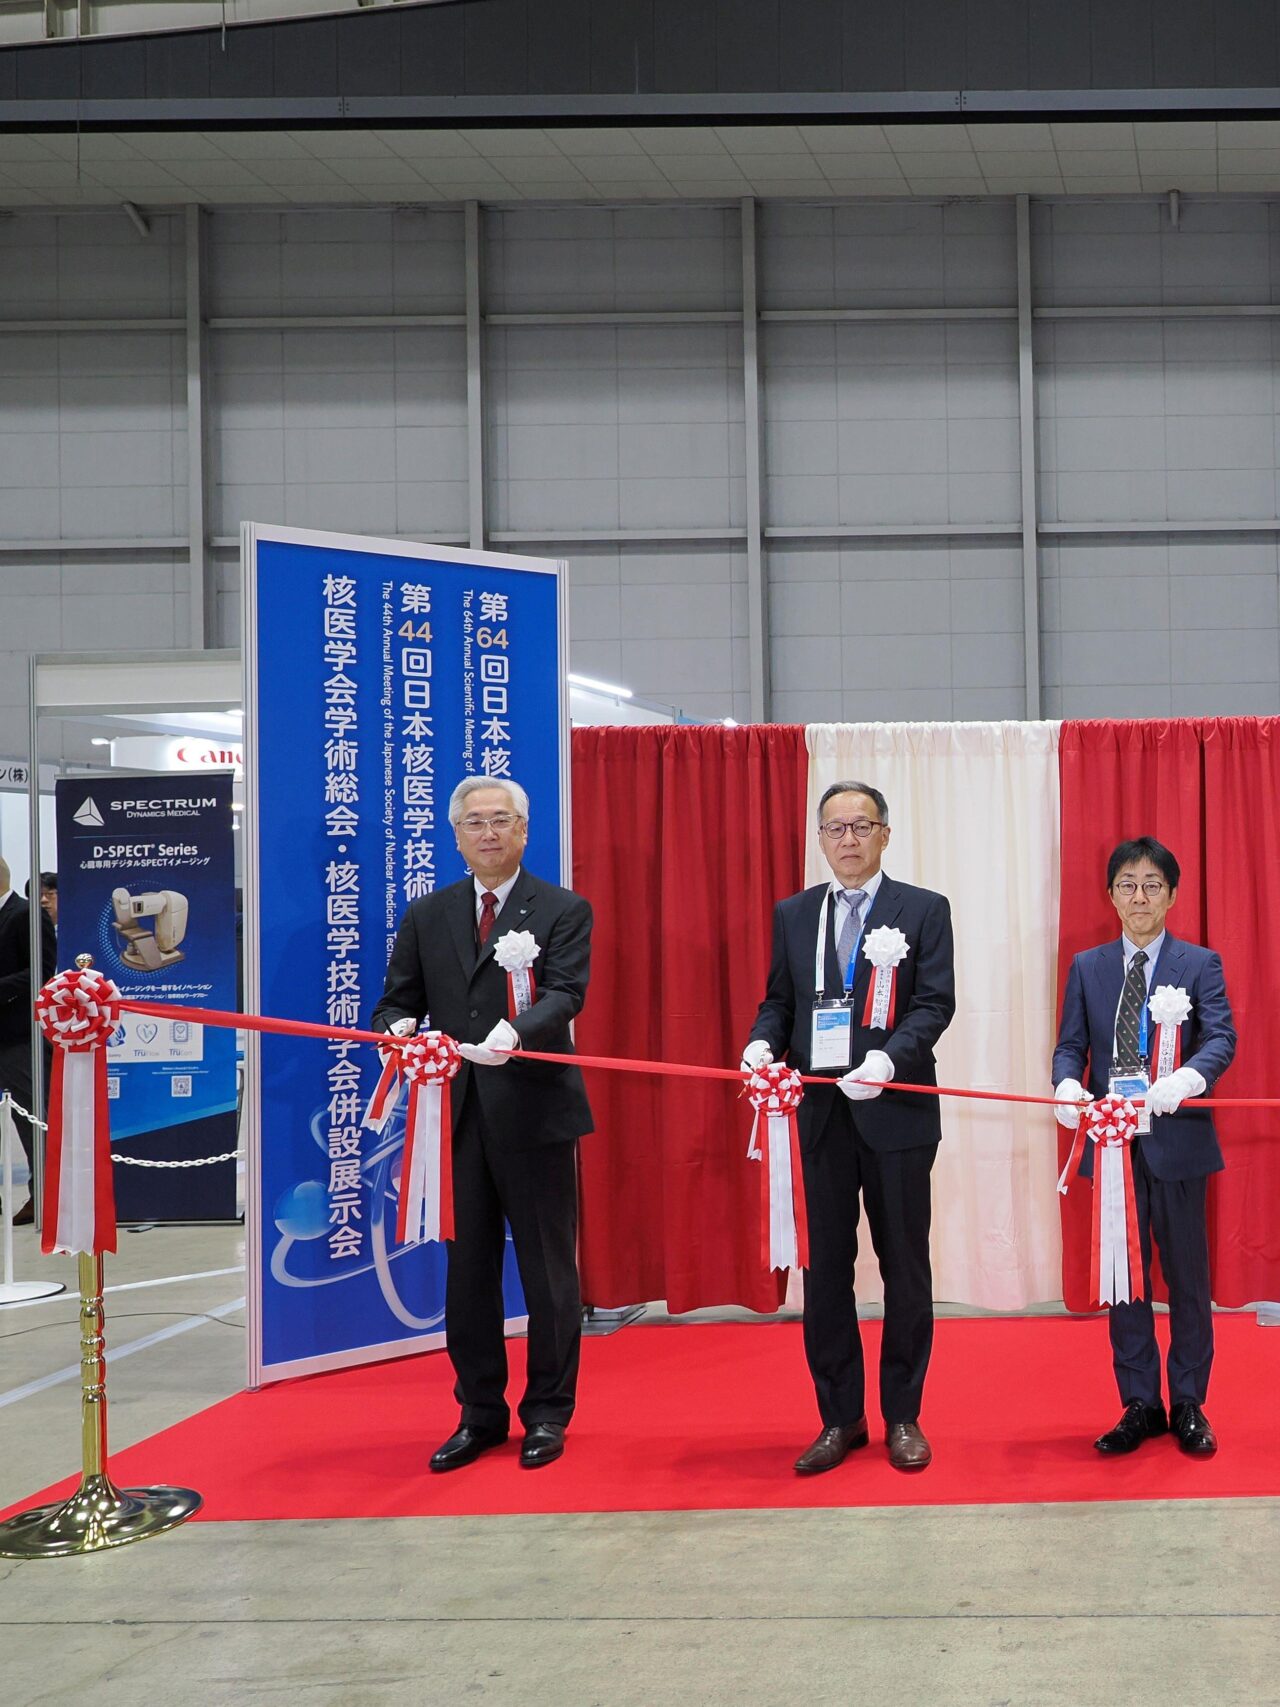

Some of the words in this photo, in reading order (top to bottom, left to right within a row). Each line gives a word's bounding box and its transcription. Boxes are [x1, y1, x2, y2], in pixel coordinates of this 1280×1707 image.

[383, 581, 393, 599] The
[464, 590, 473, 607] The
[383, 603, 393, 625] 44th
[464, 611, 473, 633] 64th
[383, 628, 393, 662] Annual
[464, 636, 473, 669] Annual
[381, 665, 393, 705] Meeting
[464, 672, 474, 715] Scientific
[384, 709, 394, 719] of
[384, 723, 394, 738] the
[463, 719, 474, 758] Meeting
[382, 741, 394, 786] Japanese
[466, 761, 475, 772] of
[110, 797, 217, 811] SPECTRUM
[383, 789, 395, 825] Society
[385, 828, 395, 839] of
[158, 843, 198, 857] Series
[386, 843, 395, 880] Nuclear
[386, 884, 396, 928] Medicine
